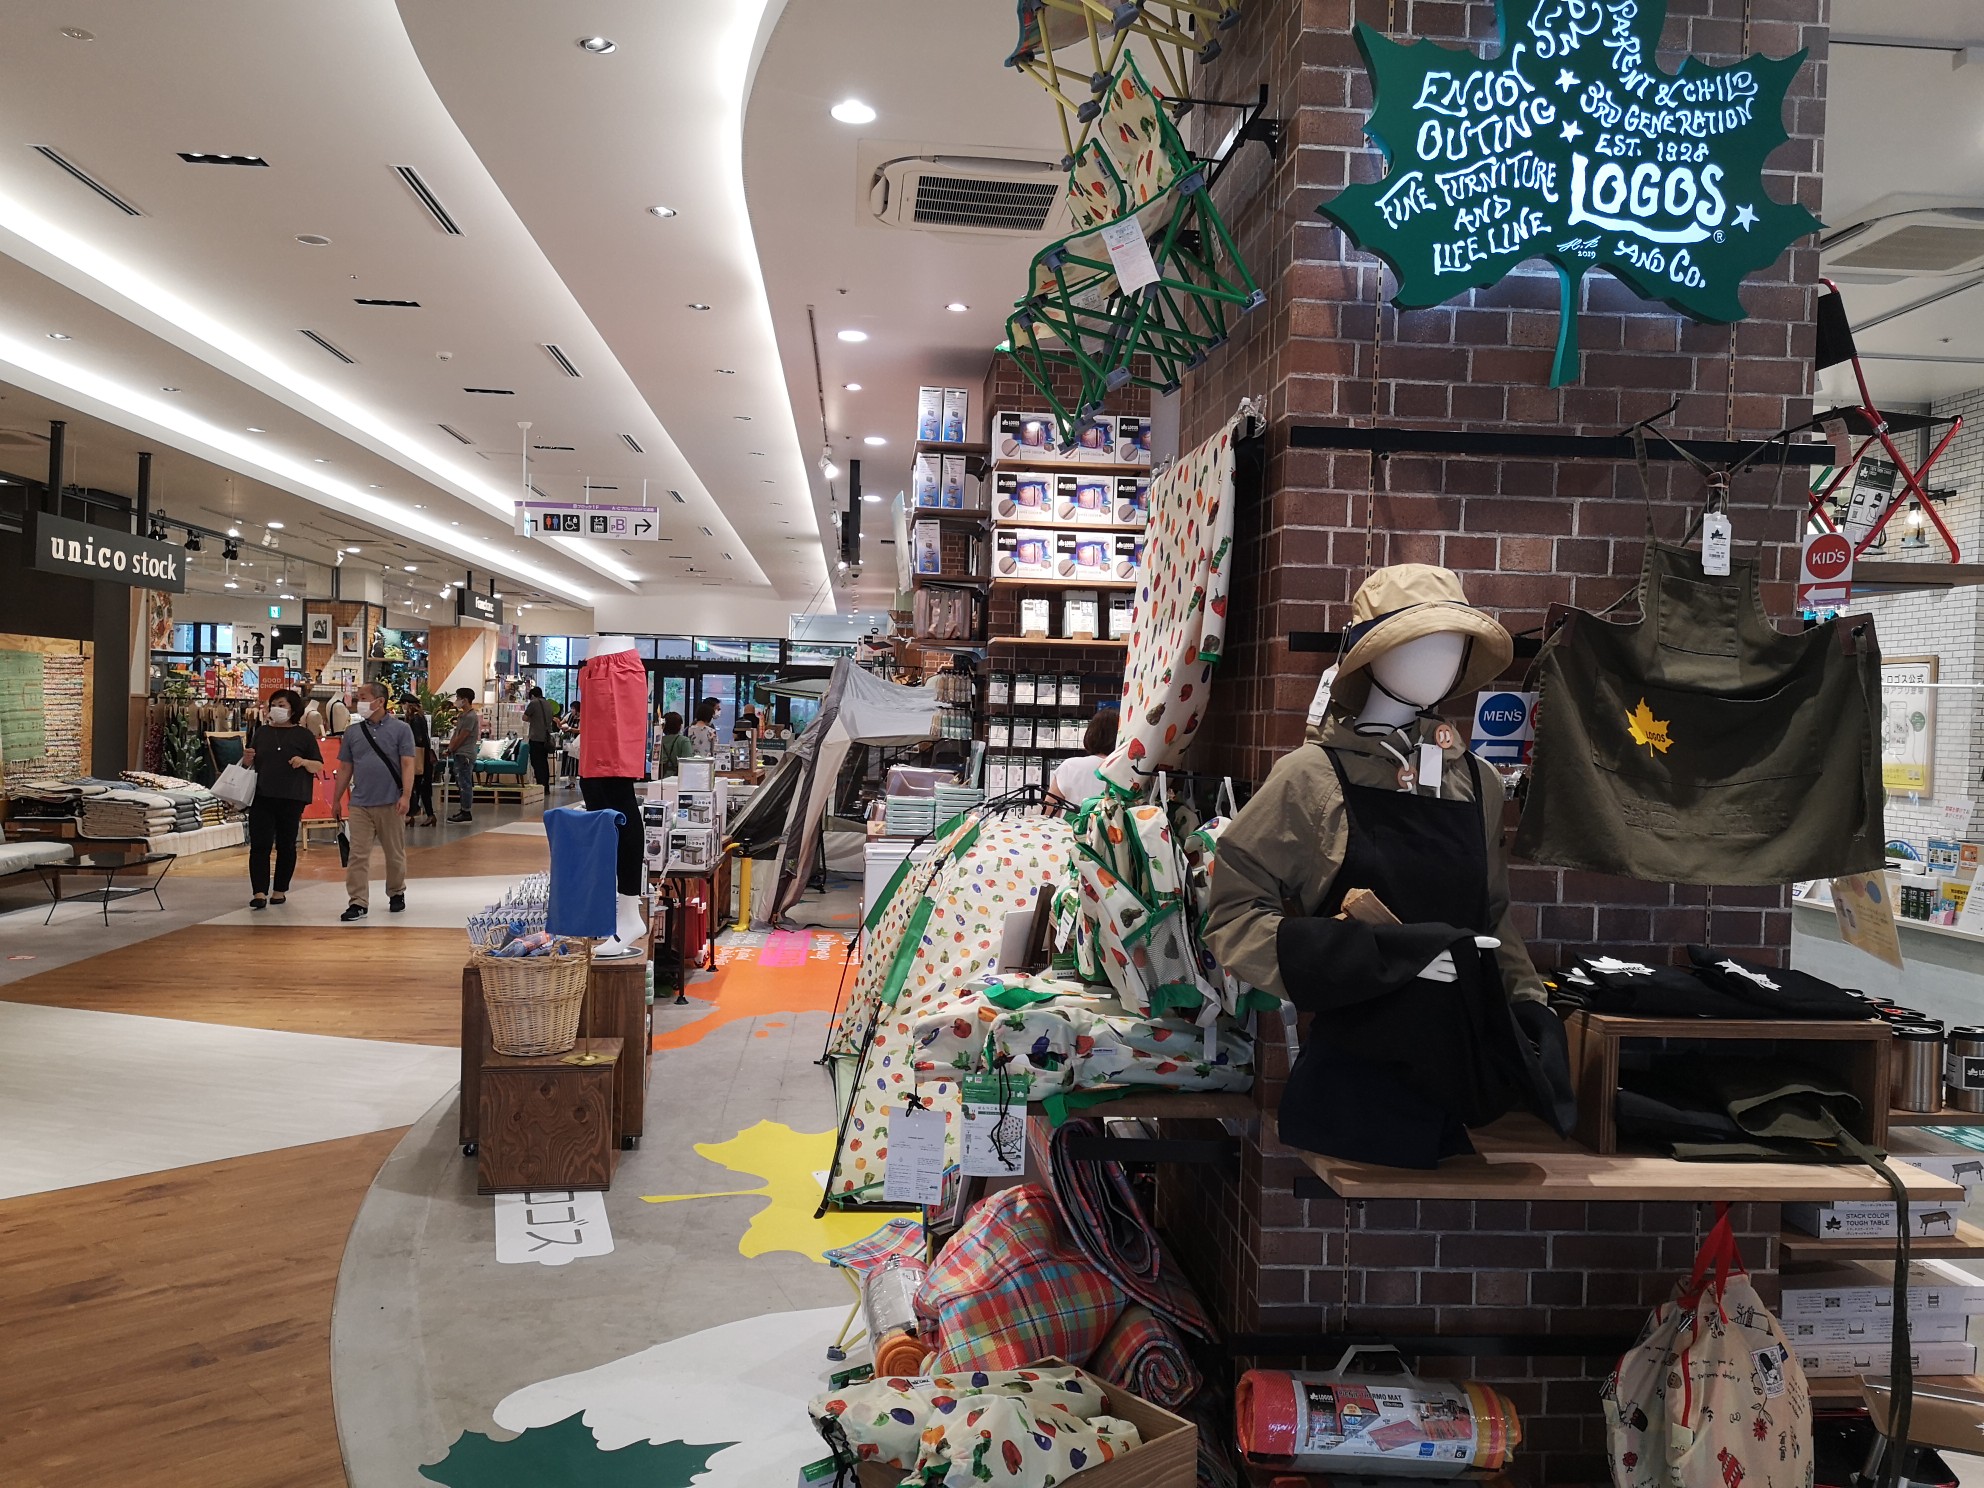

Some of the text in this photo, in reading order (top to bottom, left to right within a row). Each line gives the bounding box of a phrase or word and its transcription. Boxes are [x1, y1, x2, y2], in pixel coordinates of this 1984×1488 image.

[1603, 0, 1655, 99] PARENT
[1683, 71, 1758, 102] CHILD
[1412, 43, 1535, 117] ENJOY
[1416, 97, 1556, 161] OUTING
[1624, 97, 1754, 138] GENERATION
[1594, 133, 1709, 162] EST. 1928
[1374, 150, 1559, 230] FINE FURNITURE
[1568, 151, 1726, 243] LOGOS
[1454, 194, 1511, 233] AND
[1432, 207, 1552, 275] LIFE LINE
[1577, 250, 1597, 259] 2019
[1614, 240, 1665, 272] AND
[50, 535, 177, 581] unico stock
[1811, 548, 1846, 566] KID'S
[1483, 709, 1523, 722] MEN'S
